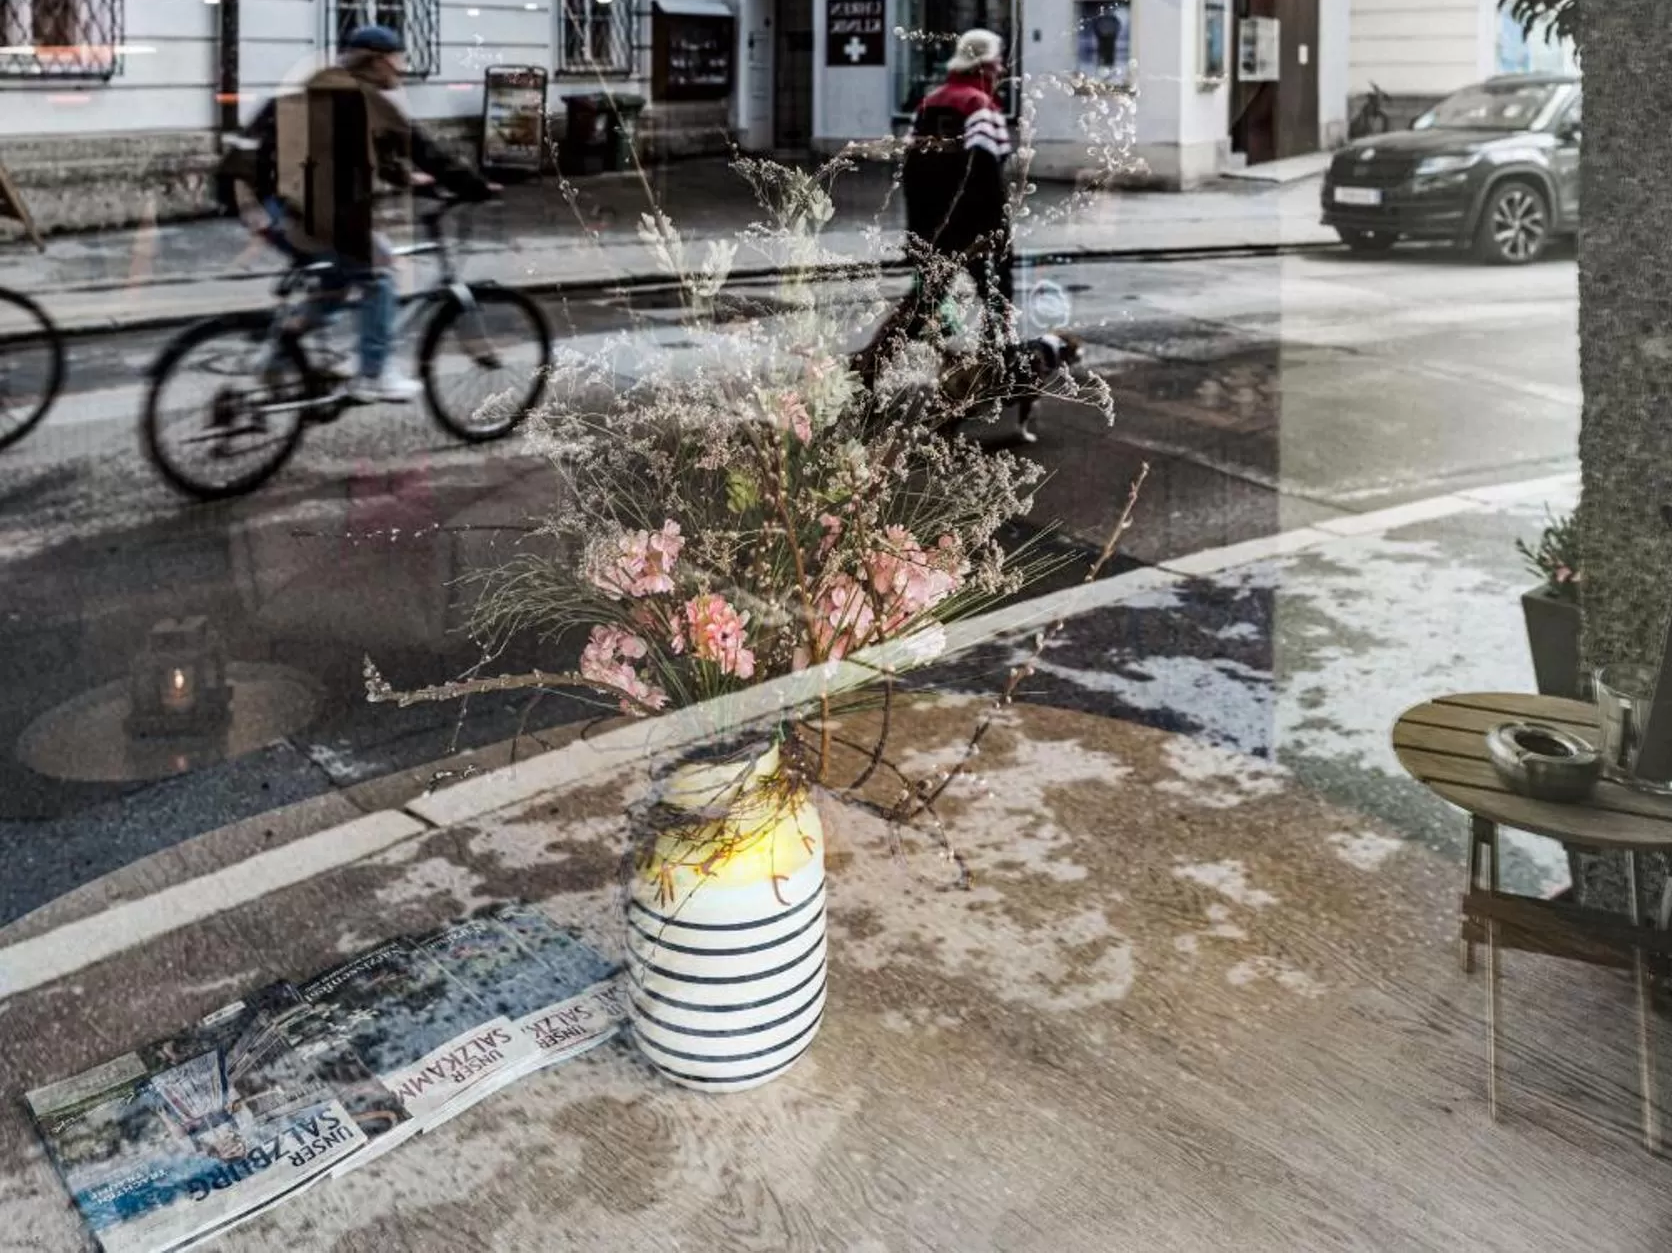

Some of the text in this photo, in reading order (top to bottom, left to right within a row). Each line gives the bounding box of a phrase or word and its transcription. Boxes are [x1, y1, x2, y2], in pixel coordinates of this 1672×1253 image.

[453, 1048, 504, 1084] UNSER
[187, 1107, 341, 1202] SALZBURG
[288, 1126, 354, 1167] UNSER
